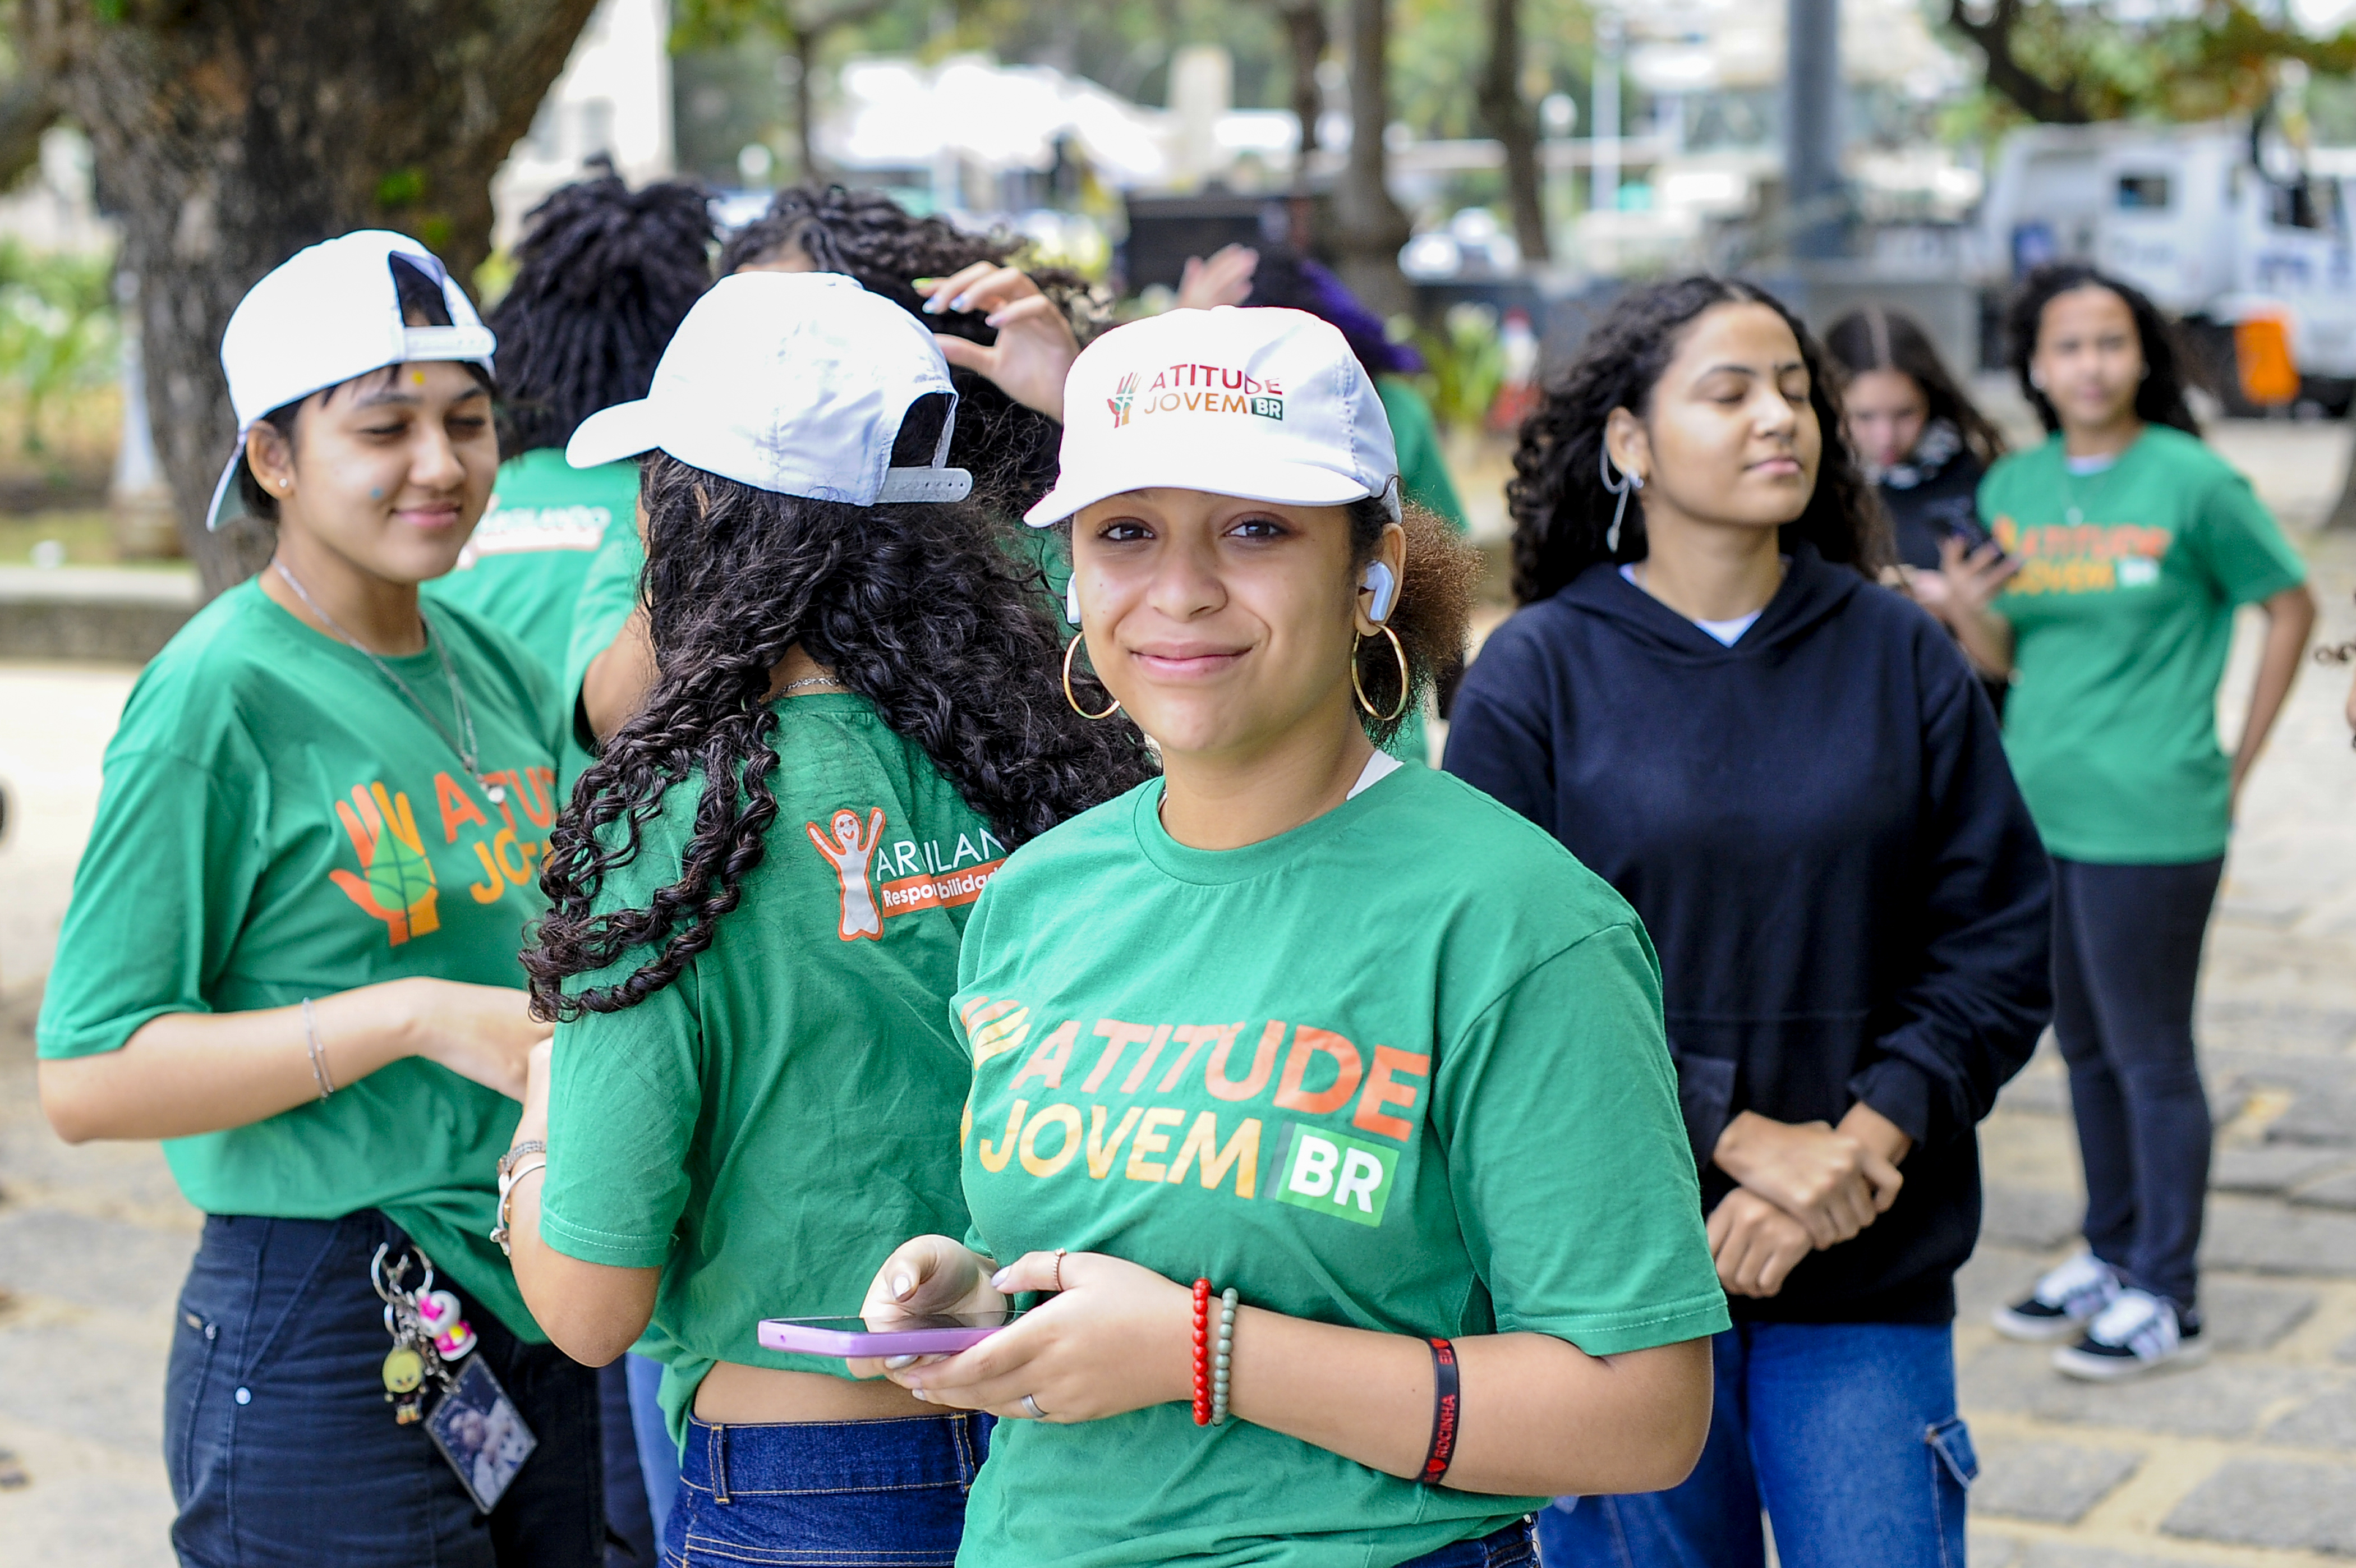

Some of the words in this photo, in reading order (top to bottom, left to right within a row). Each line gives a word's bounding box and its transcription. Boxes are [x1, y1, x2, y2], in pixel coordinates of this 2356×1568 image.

[1144, 392, 1248, 415] JOVEM
[1255, 398, 1281, 419] BR
[1149, 364, 1283, 396] ATITUDE
[1009, 1018, 1430, 1142] ATITUDE
[978, 1099, 1263, 1200] JOVEM
[1287, 1134, 1384, 1214] BR
[1434, 1394, 1455, 1458] ROCINHA
